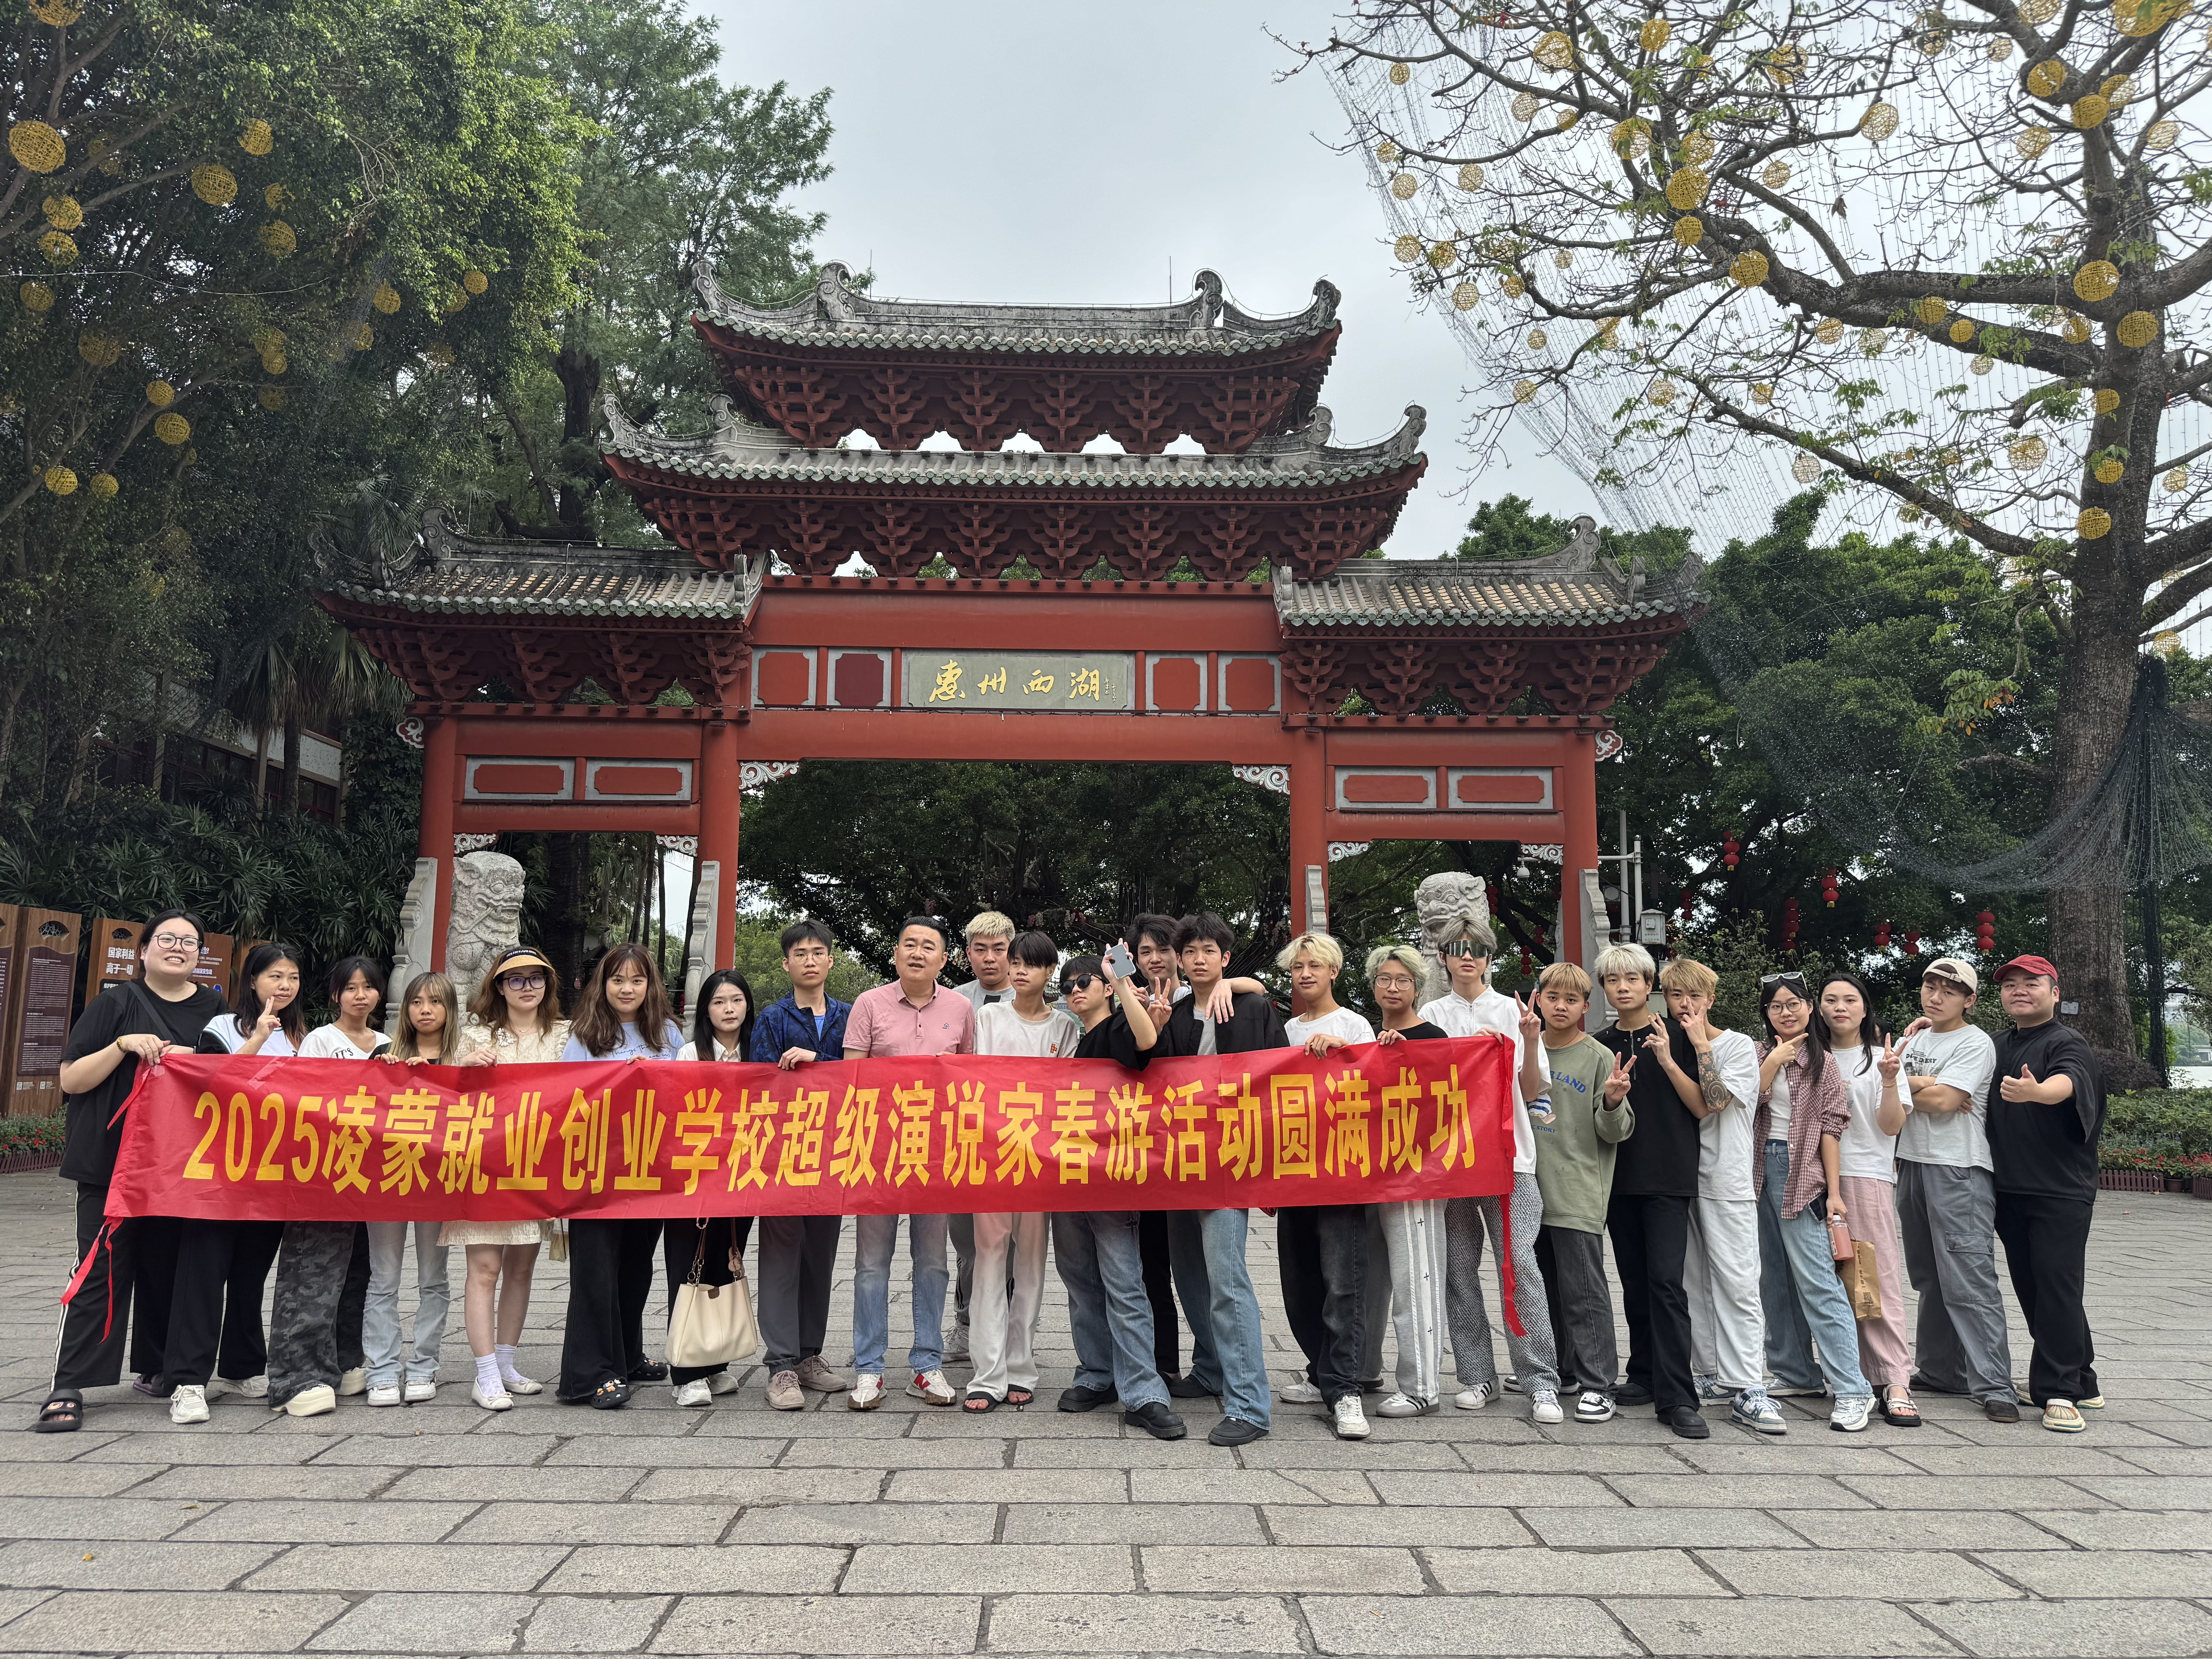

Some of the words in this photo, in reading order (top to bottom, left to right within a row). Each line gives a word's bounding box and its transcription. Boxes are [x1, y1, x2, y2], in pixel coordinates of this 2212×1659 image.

[929, 659, 1099, 702] 惠州西湖
[108, 947, 135, 960] 国家利益
[106, 962, 134, 975] 高于一切
[1556, 1072, 1587, 1094] LAND
[182, 1064, 1475, 1196] 2025凌蒙就业创业学校超级演说家春游活动圆满成功
